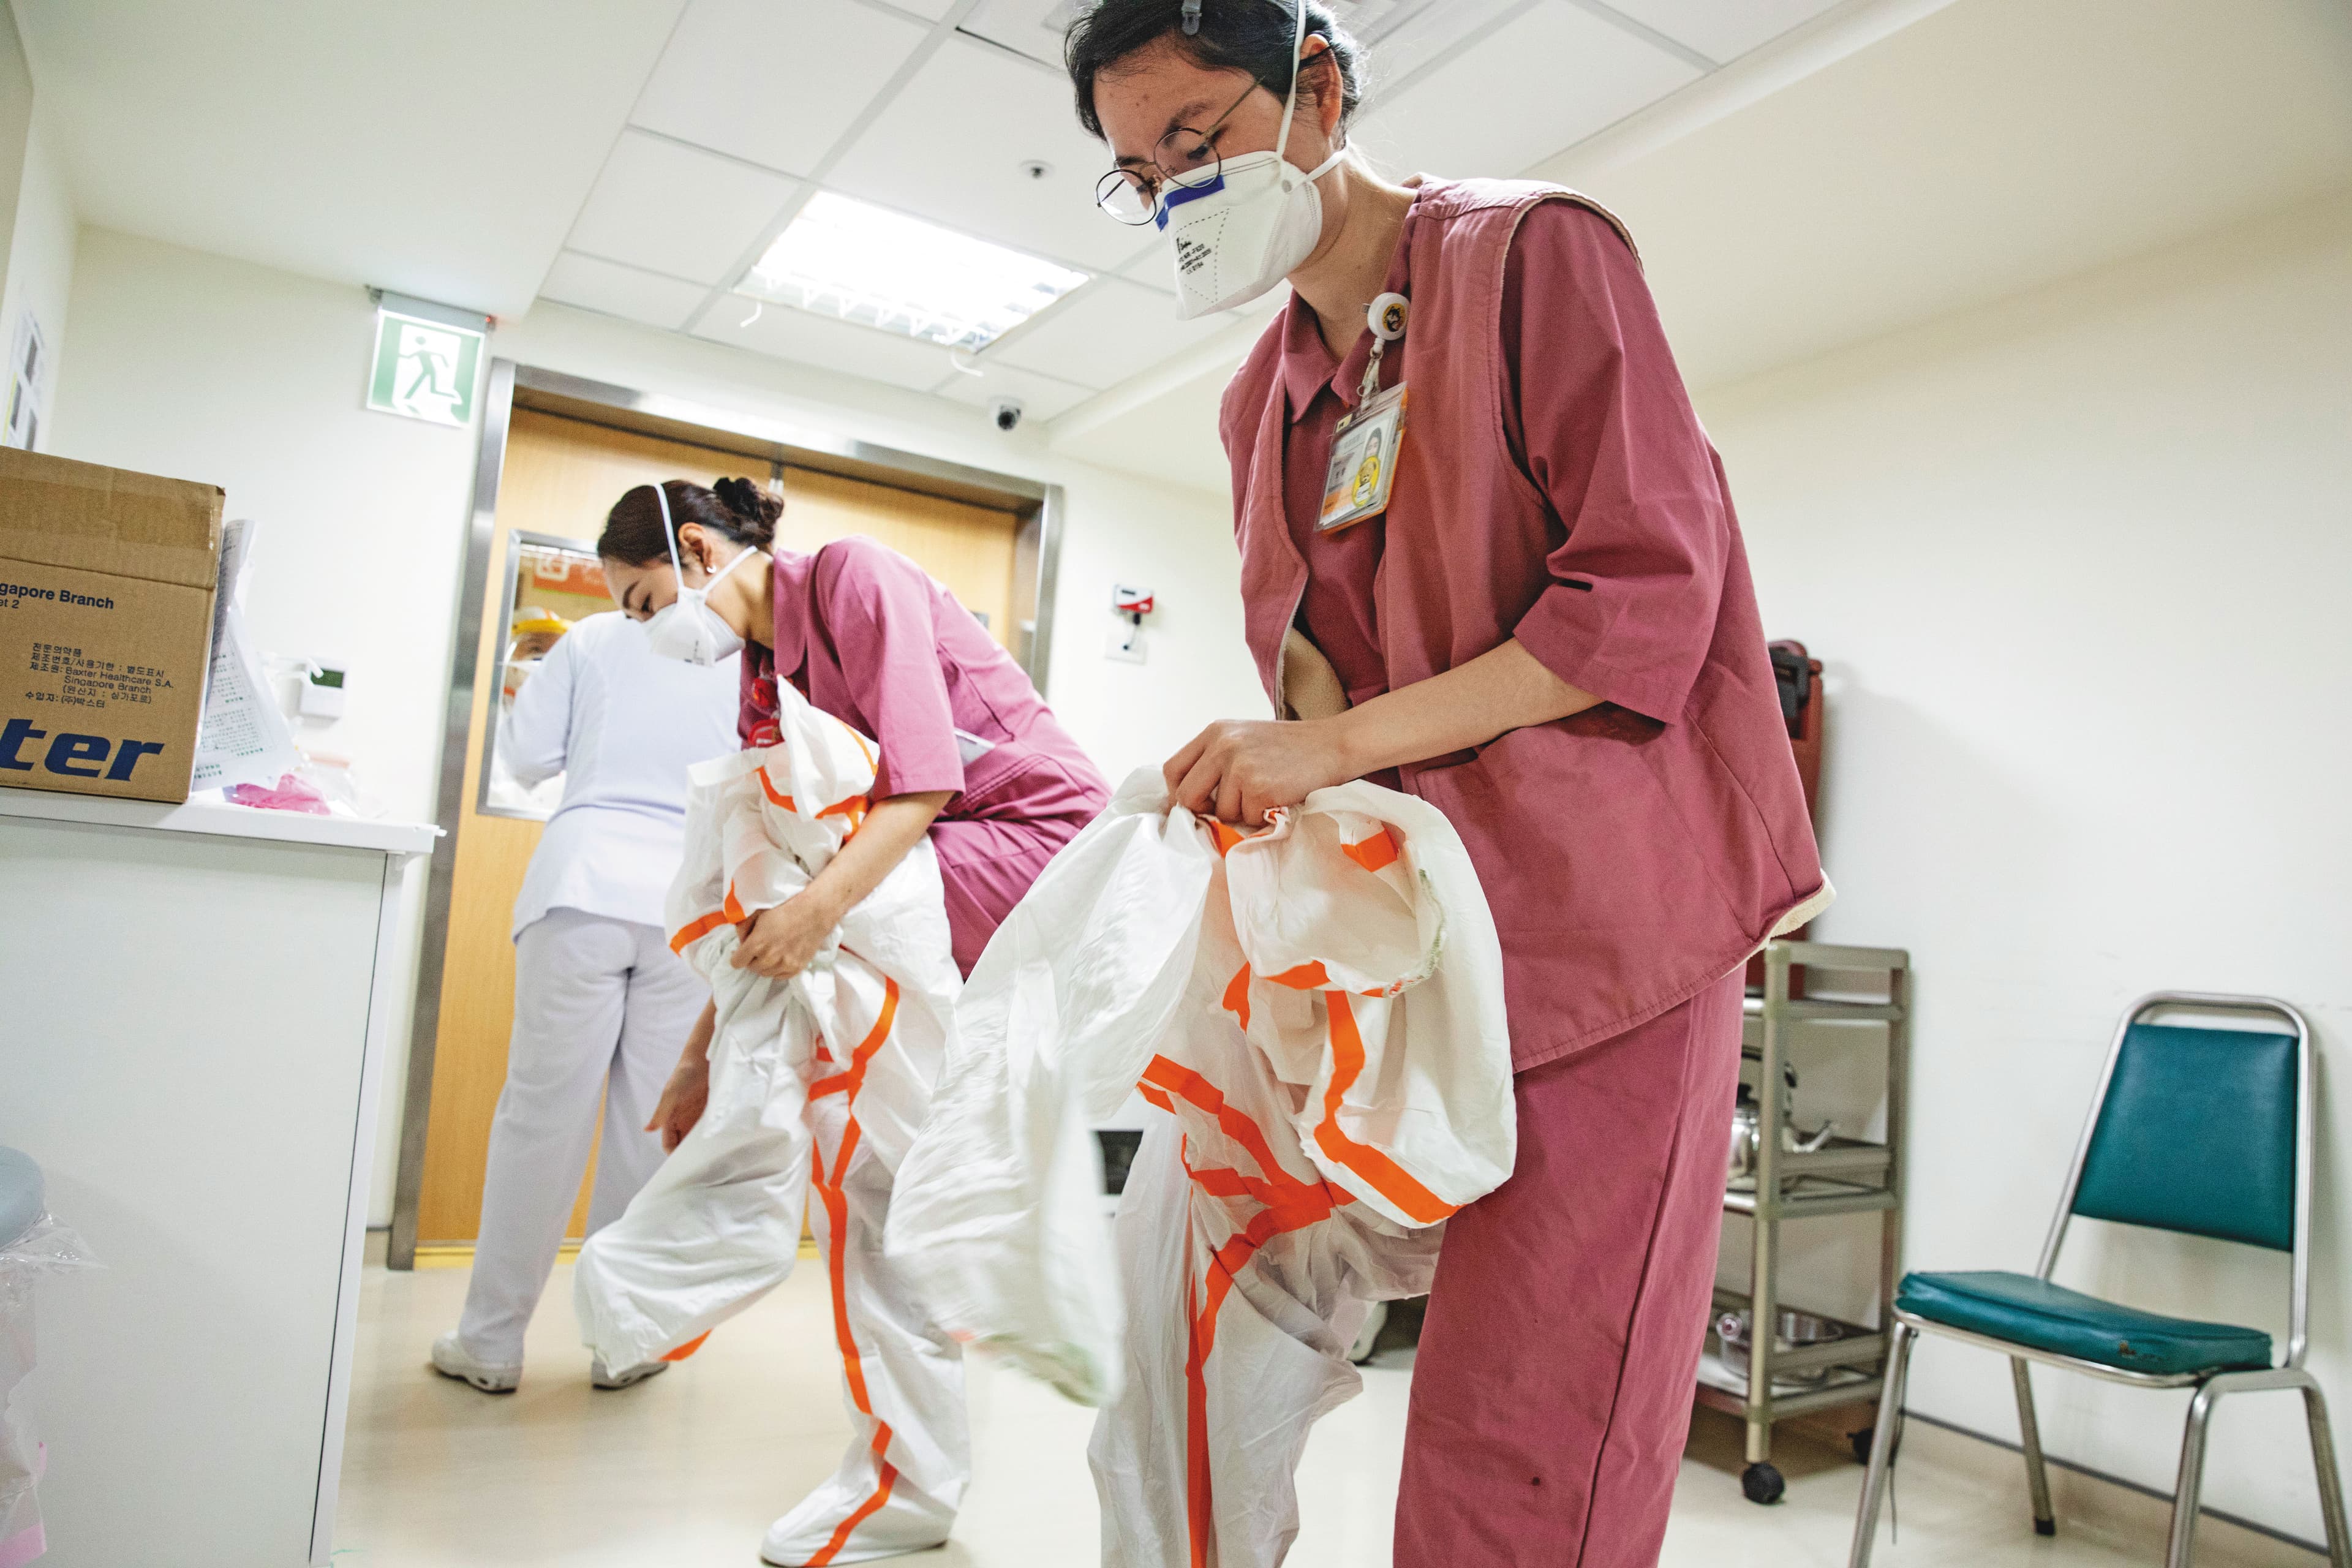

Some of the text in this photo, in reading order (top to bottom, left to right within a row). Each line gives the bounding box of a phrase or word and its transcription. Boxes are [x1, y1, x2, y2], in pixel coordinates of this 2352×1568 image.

[12, 599, 20, 609] 2
[59, 590, 114, 609] Branch
[64, 676, 151, 694] Singapore Branch
[66, 666, 97, 677] Baxter
[100, 671, 151, 685] Healthcare
[154, 678, 174, 688] S.A.
[0, 718, 165, 782] ter
